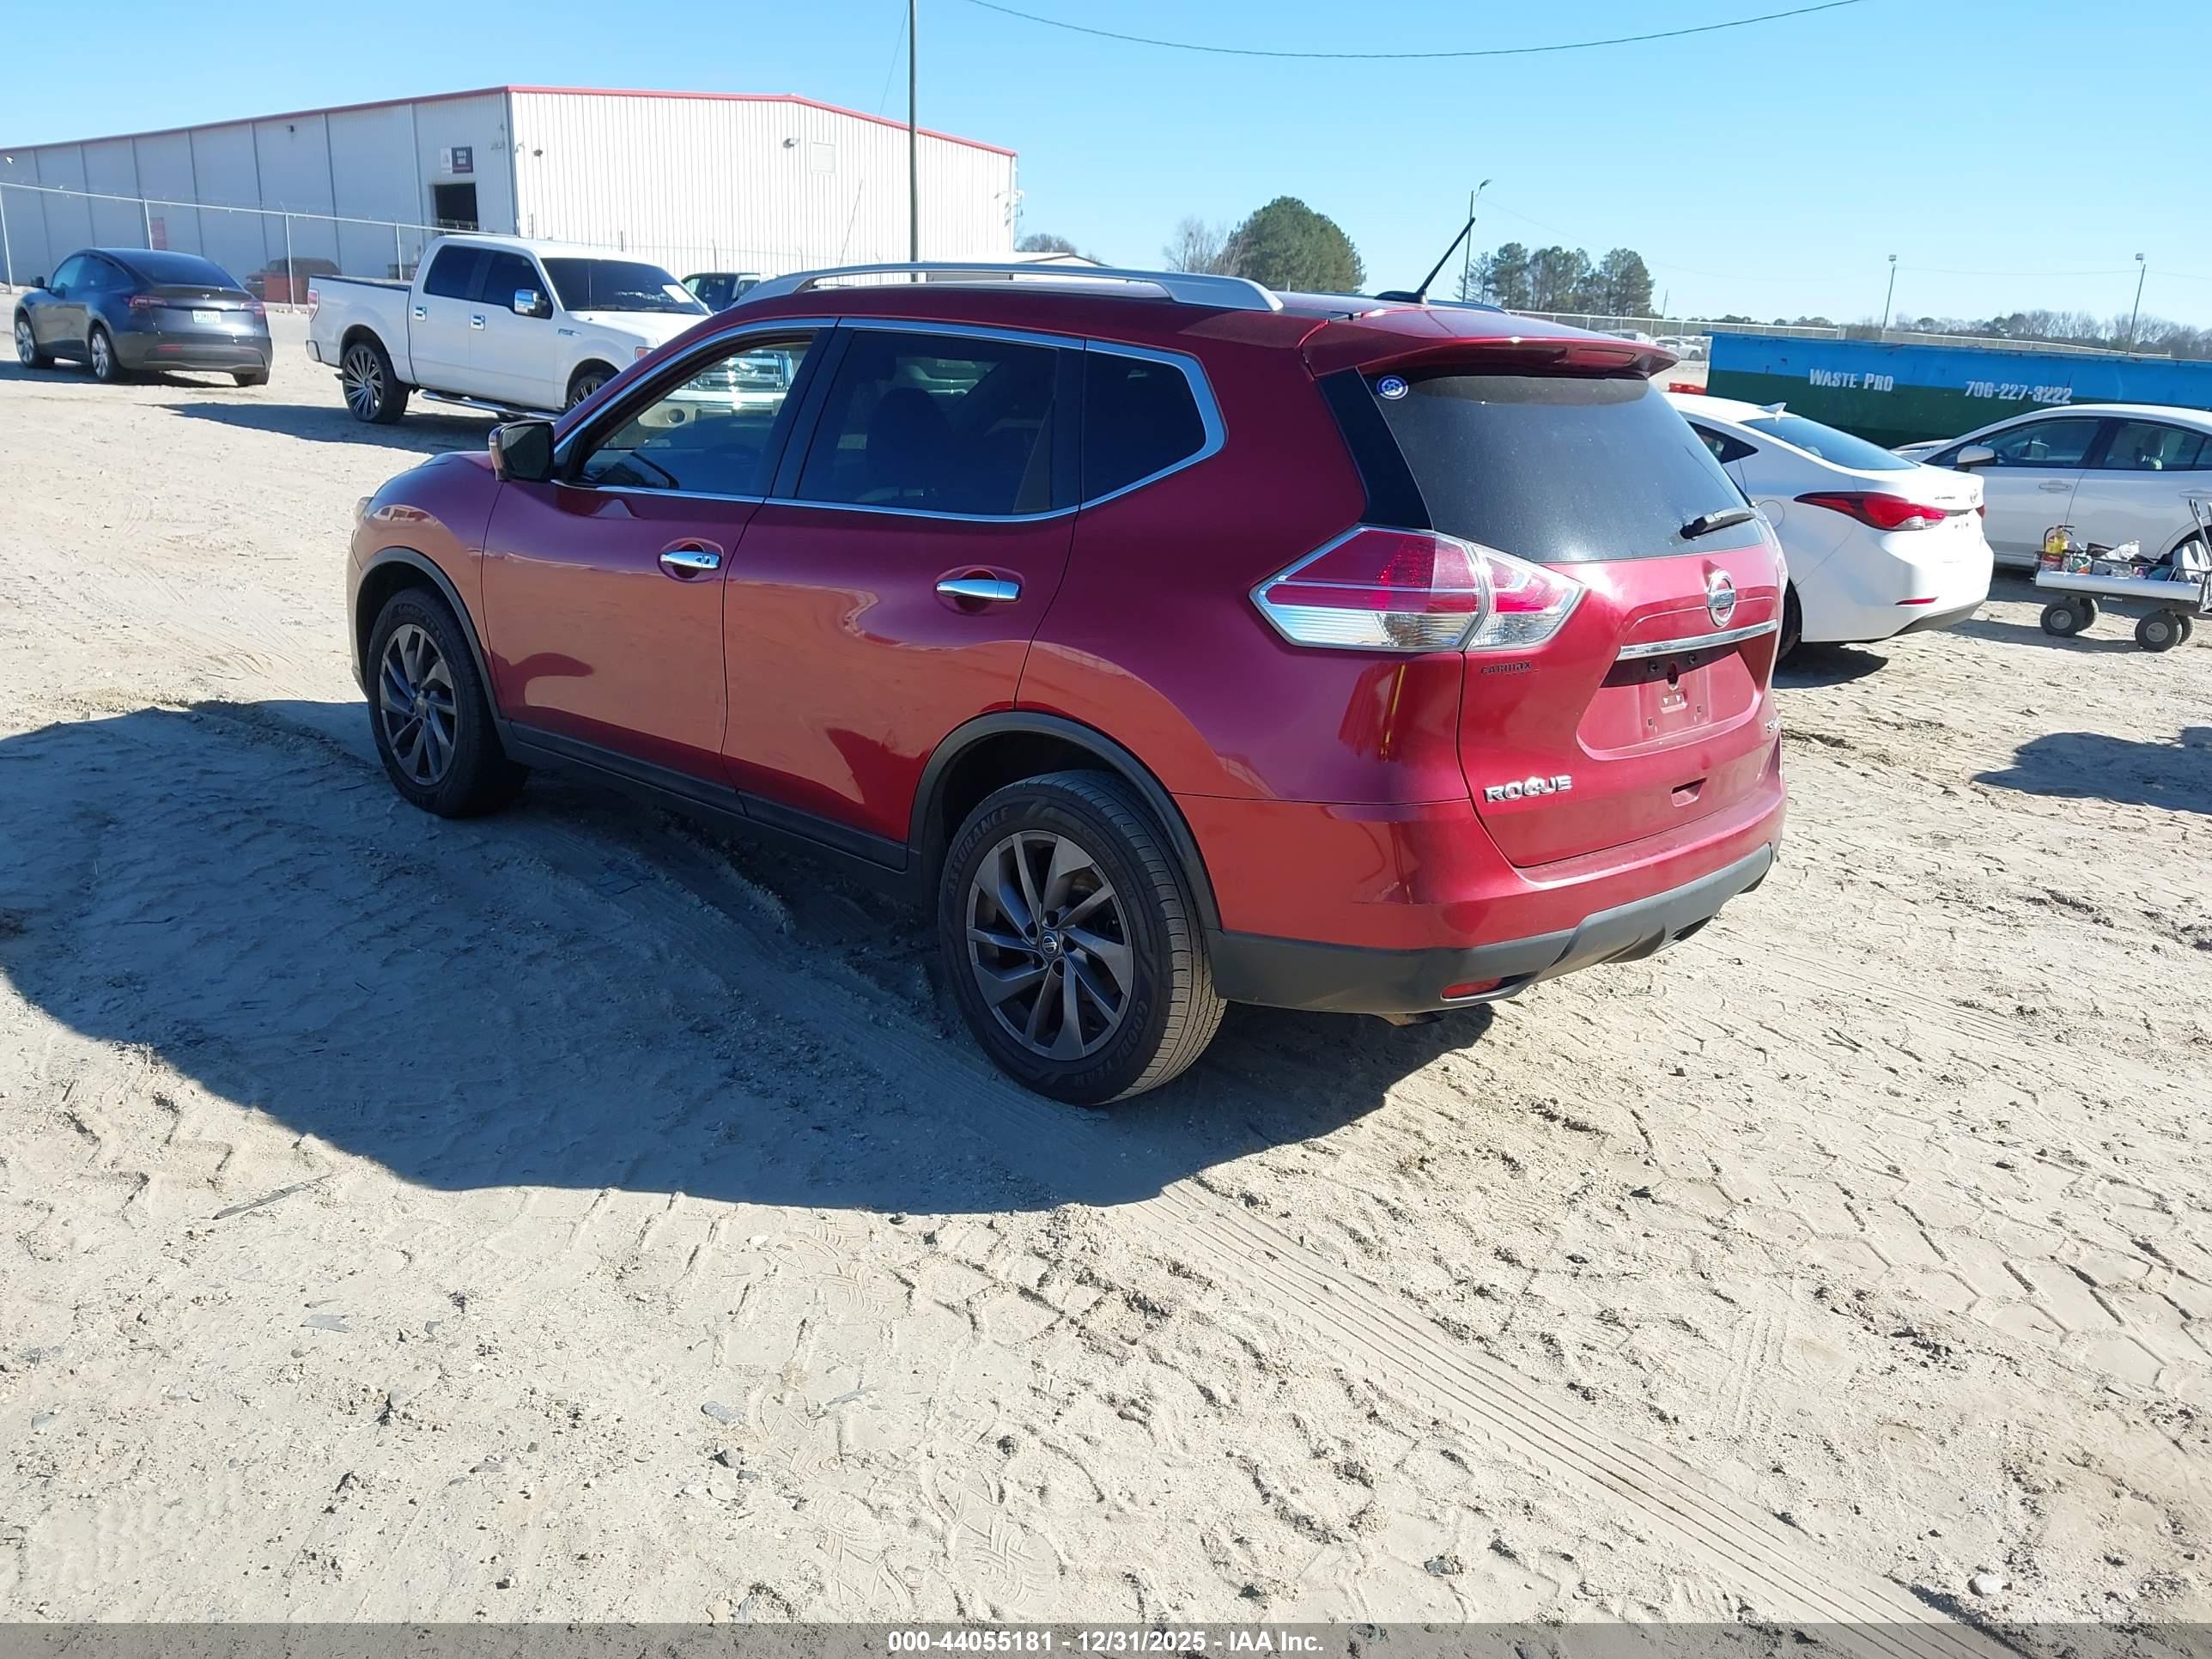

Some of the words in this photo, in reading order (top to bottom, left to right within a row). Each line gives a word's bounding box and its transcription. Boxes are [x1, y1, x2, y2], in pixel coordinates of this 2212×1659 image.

[1808, 368, 1858, 389] WASTE
[1863, 372, 1894, 392] PRO
[1965, 380, 2073, 404] 706-227-3222
[1483, 775, 1573, 804] ROGUE
[947, 805, 1010, 898] ASSURANCE
